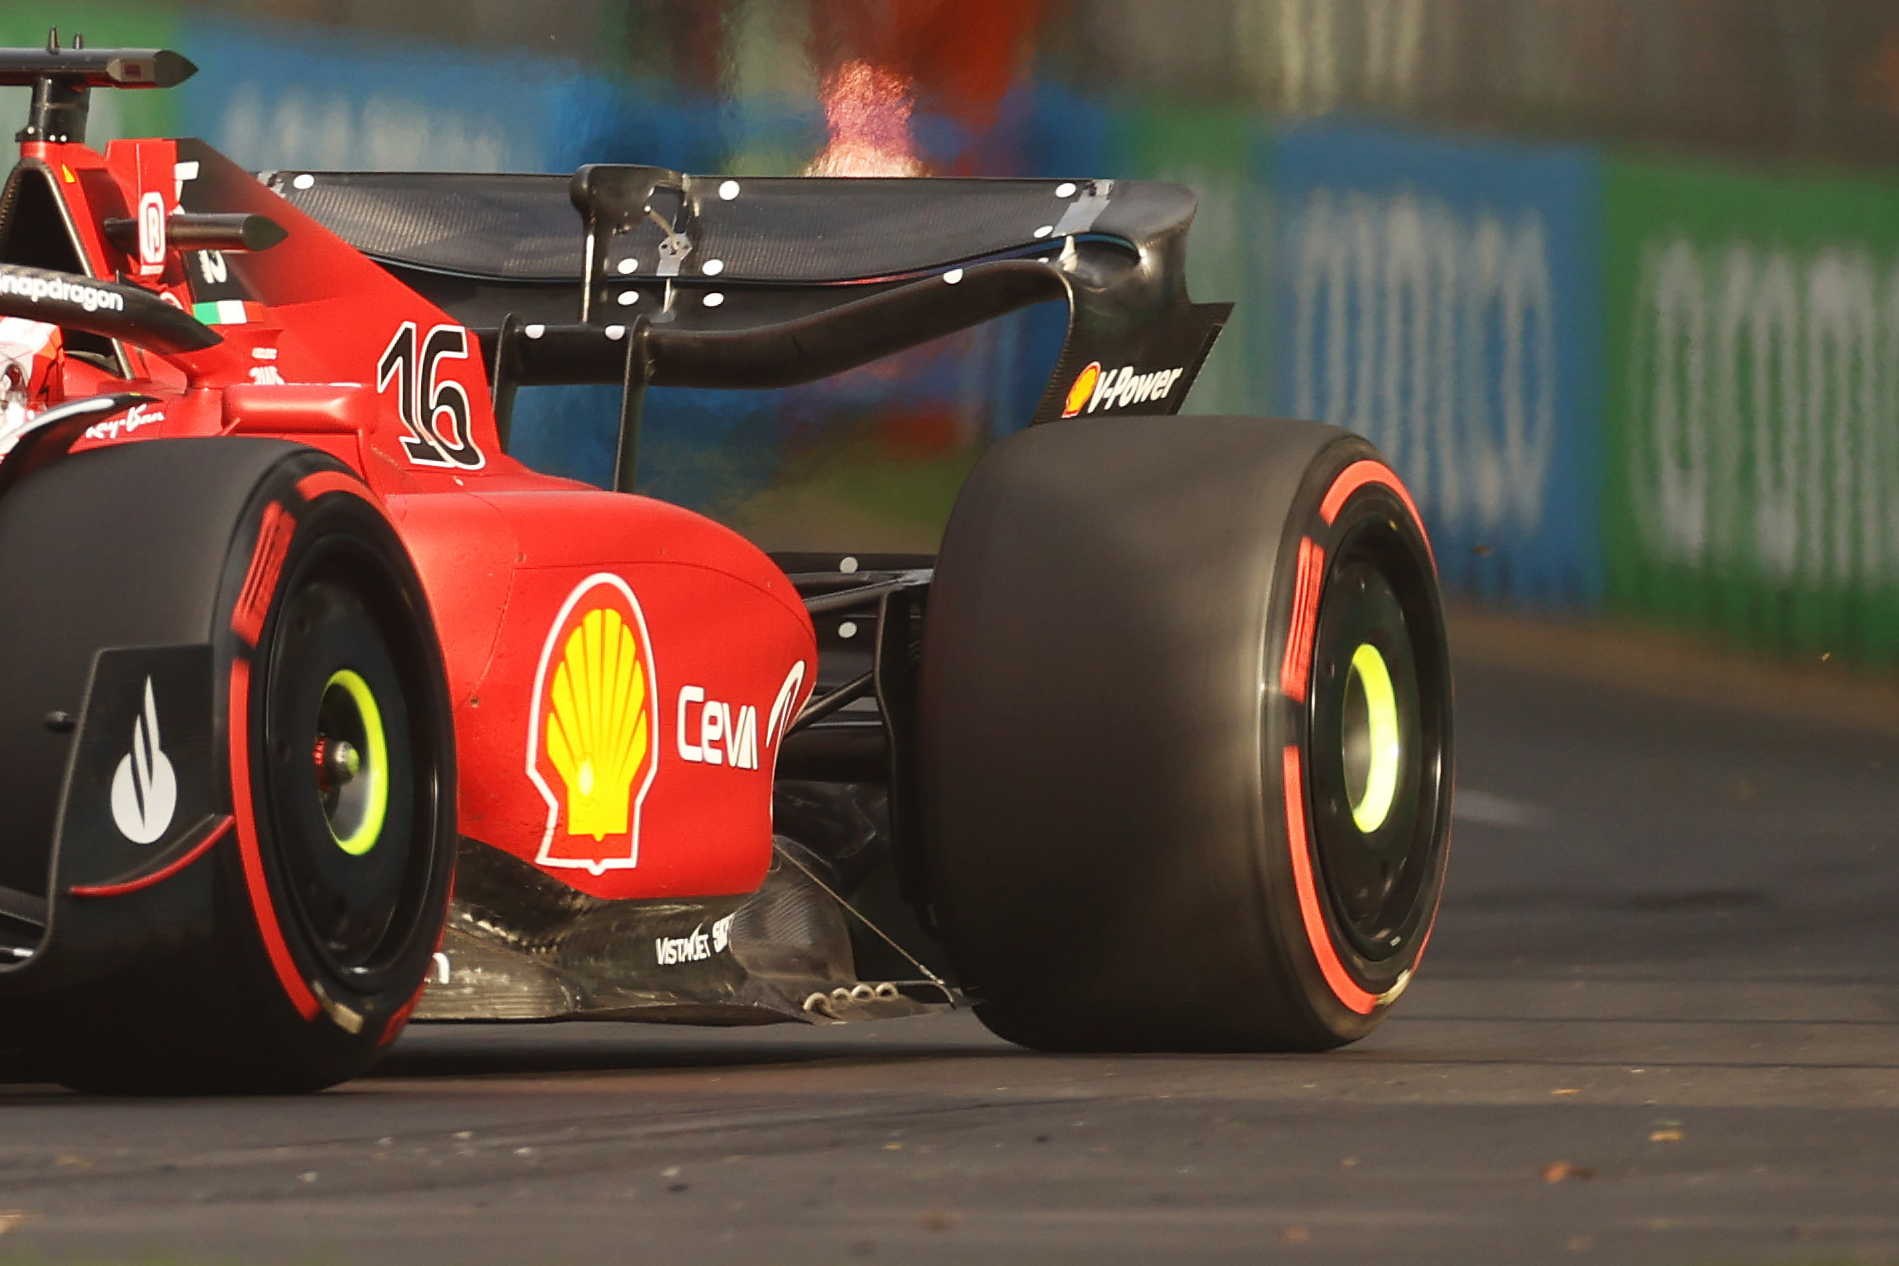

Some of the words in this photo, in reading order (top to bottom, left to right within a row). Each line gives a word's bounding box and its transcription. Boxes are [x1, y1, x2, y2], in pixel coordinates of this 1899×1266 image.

[377, 321, 486, 470] 16
[1088, 366, 1183, 414] V-Power
[86, 403, 164, 438] Ray-Ban
